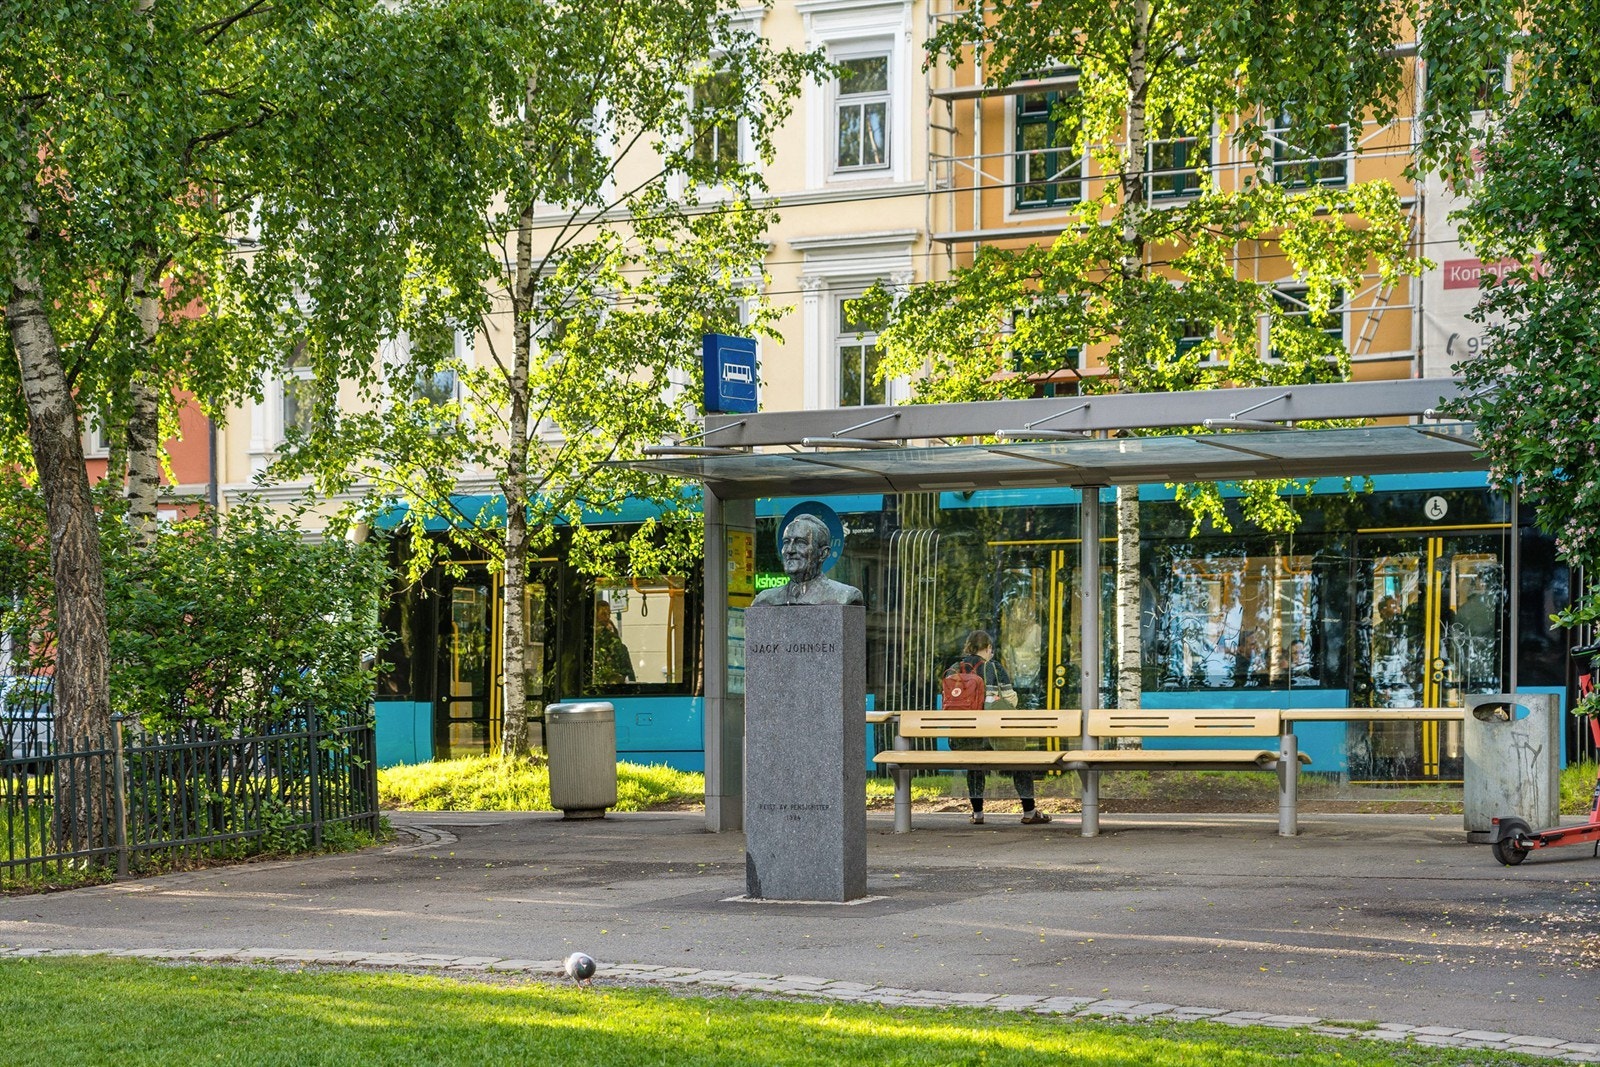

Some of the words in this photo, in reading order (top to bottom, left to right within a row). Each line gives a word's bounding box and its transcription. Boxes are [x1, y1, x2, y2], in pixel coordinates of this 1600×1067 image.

[755, 573, 790, 589] kshosp
[752, 643, 780, 653] JACK
[786, 643, 836, 653] JOHNSEN
